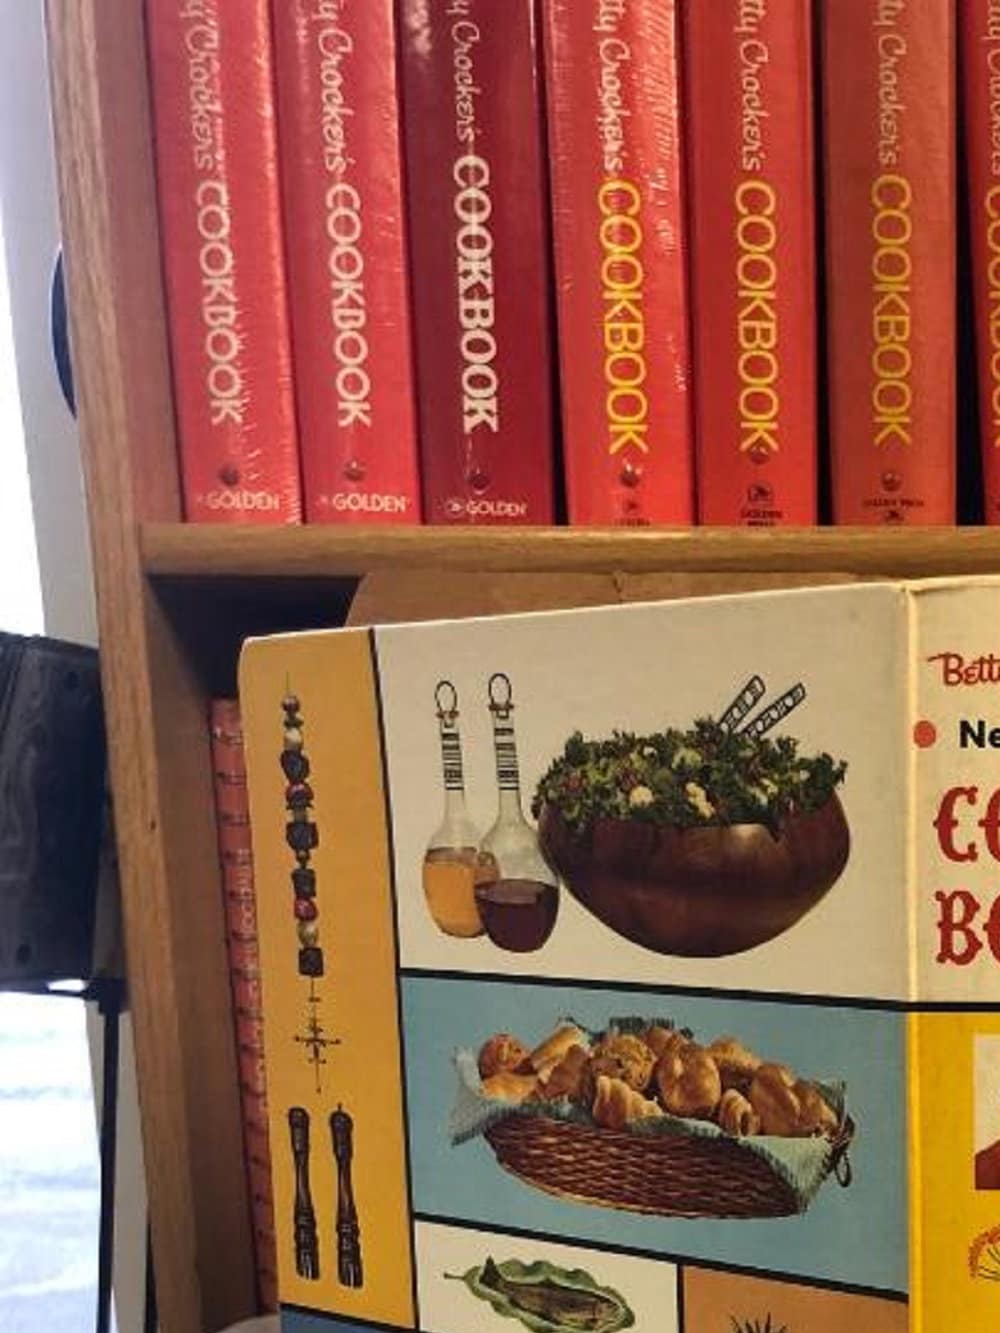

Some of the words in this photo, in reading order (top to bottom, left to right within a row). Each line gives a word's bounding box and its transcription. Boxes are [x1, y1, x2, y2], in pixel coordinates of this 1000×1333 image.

[197, 181, 243, 424] COOKBOOK
[325, 183, 372, 428] COOKBOOK
[453, 154, 499, 434] COOKBOOK
[598, 180, 650, 455] COOKBOOK
[735, 180, 781, 452] COOKBOOK
[871, 174, 913, 447] COOKBOOK
[207, 491, 281, 511] GOLDEN
[333, 492, 407, 512] GOLDEN
[466, 499, 528, 517] GOLDEN
